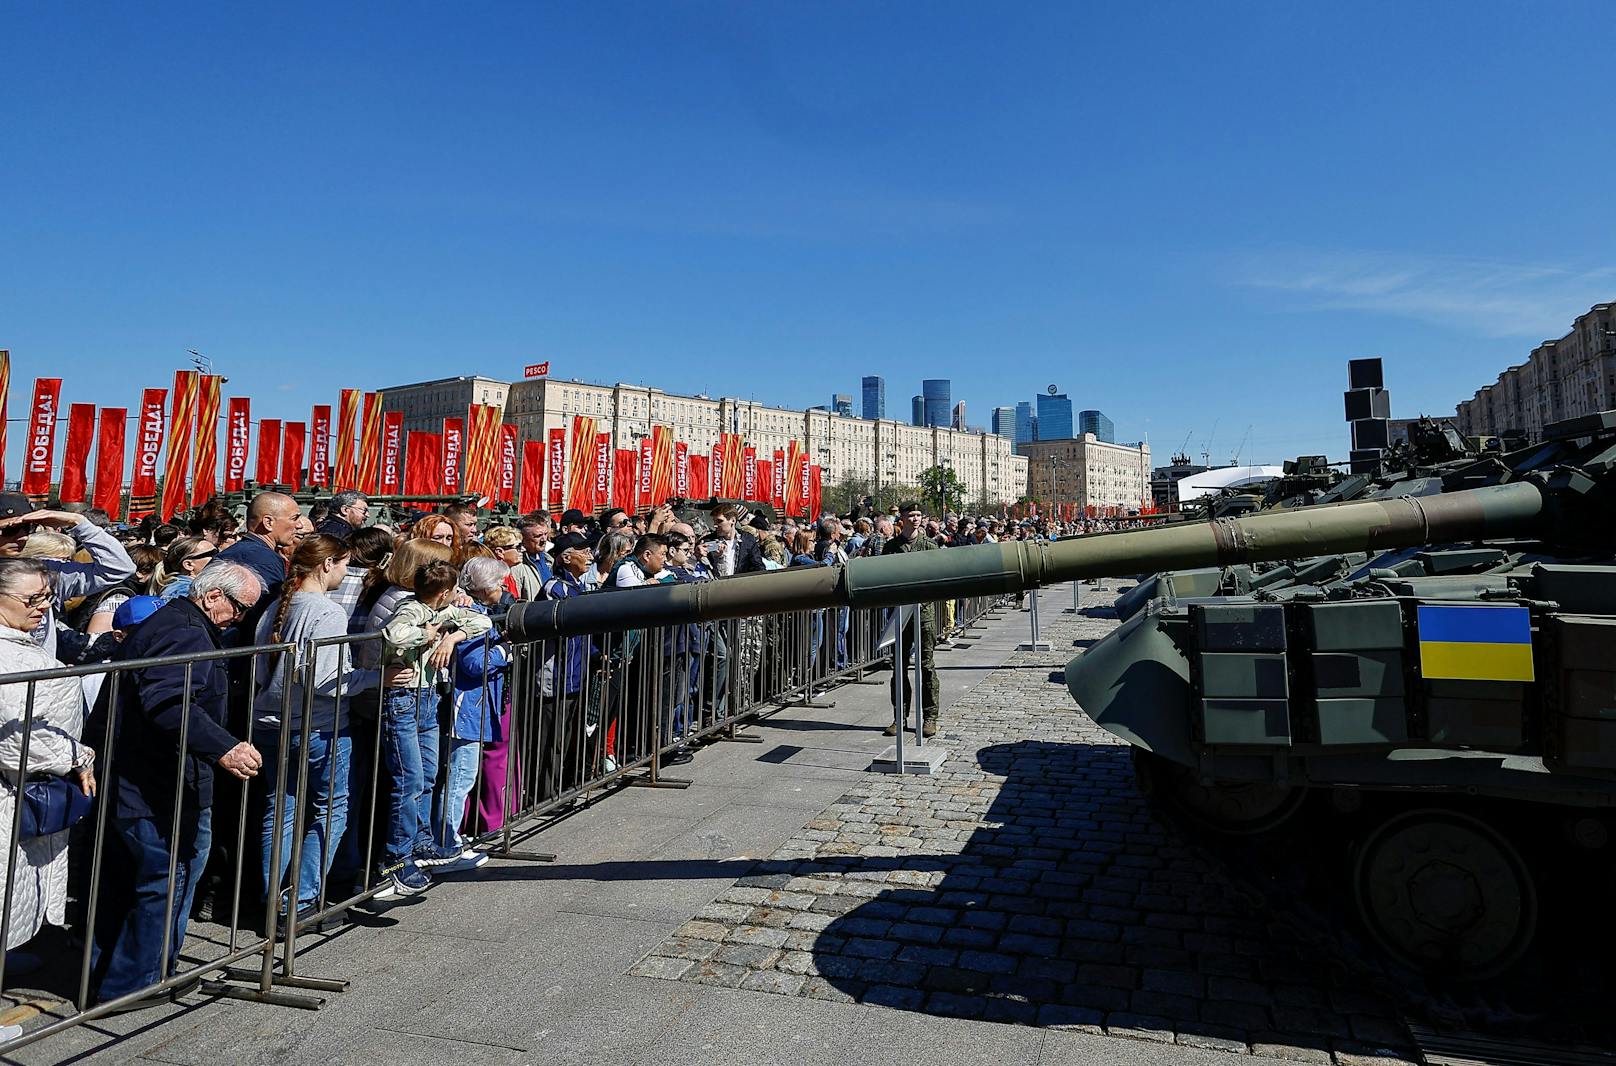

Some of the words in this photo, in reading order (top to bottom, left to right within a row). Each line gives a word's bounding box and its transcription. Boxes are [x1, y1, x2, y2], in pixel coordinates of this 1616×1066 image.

[30, 394, 55, 472] ПОБЕДА!
[141, 404, 162, 477] ПОБЕДА!
[230, 411, 248, 479] ПОБЕДА!
[313, 419, 329, 482] ПОБЕДА!
[385, 424, 400, 484] ПОБЕДА!
[444, 429, 460, 485] ПОБЕДА!
[503, 435, 515, 488] ПОБЕДА!
[551, 439, 563, 490] ПОБЕДА!
[597, 443, 608, 491] ПОБЕДА!
[641, 446, 653, 493] ПОБЕДА!
[746, 455, 755, 496] ПОБЕДА!
[775, 458, 784, 497] ПОБЕДА!
[802, 460, 811, 499] ПОБЕДА!
